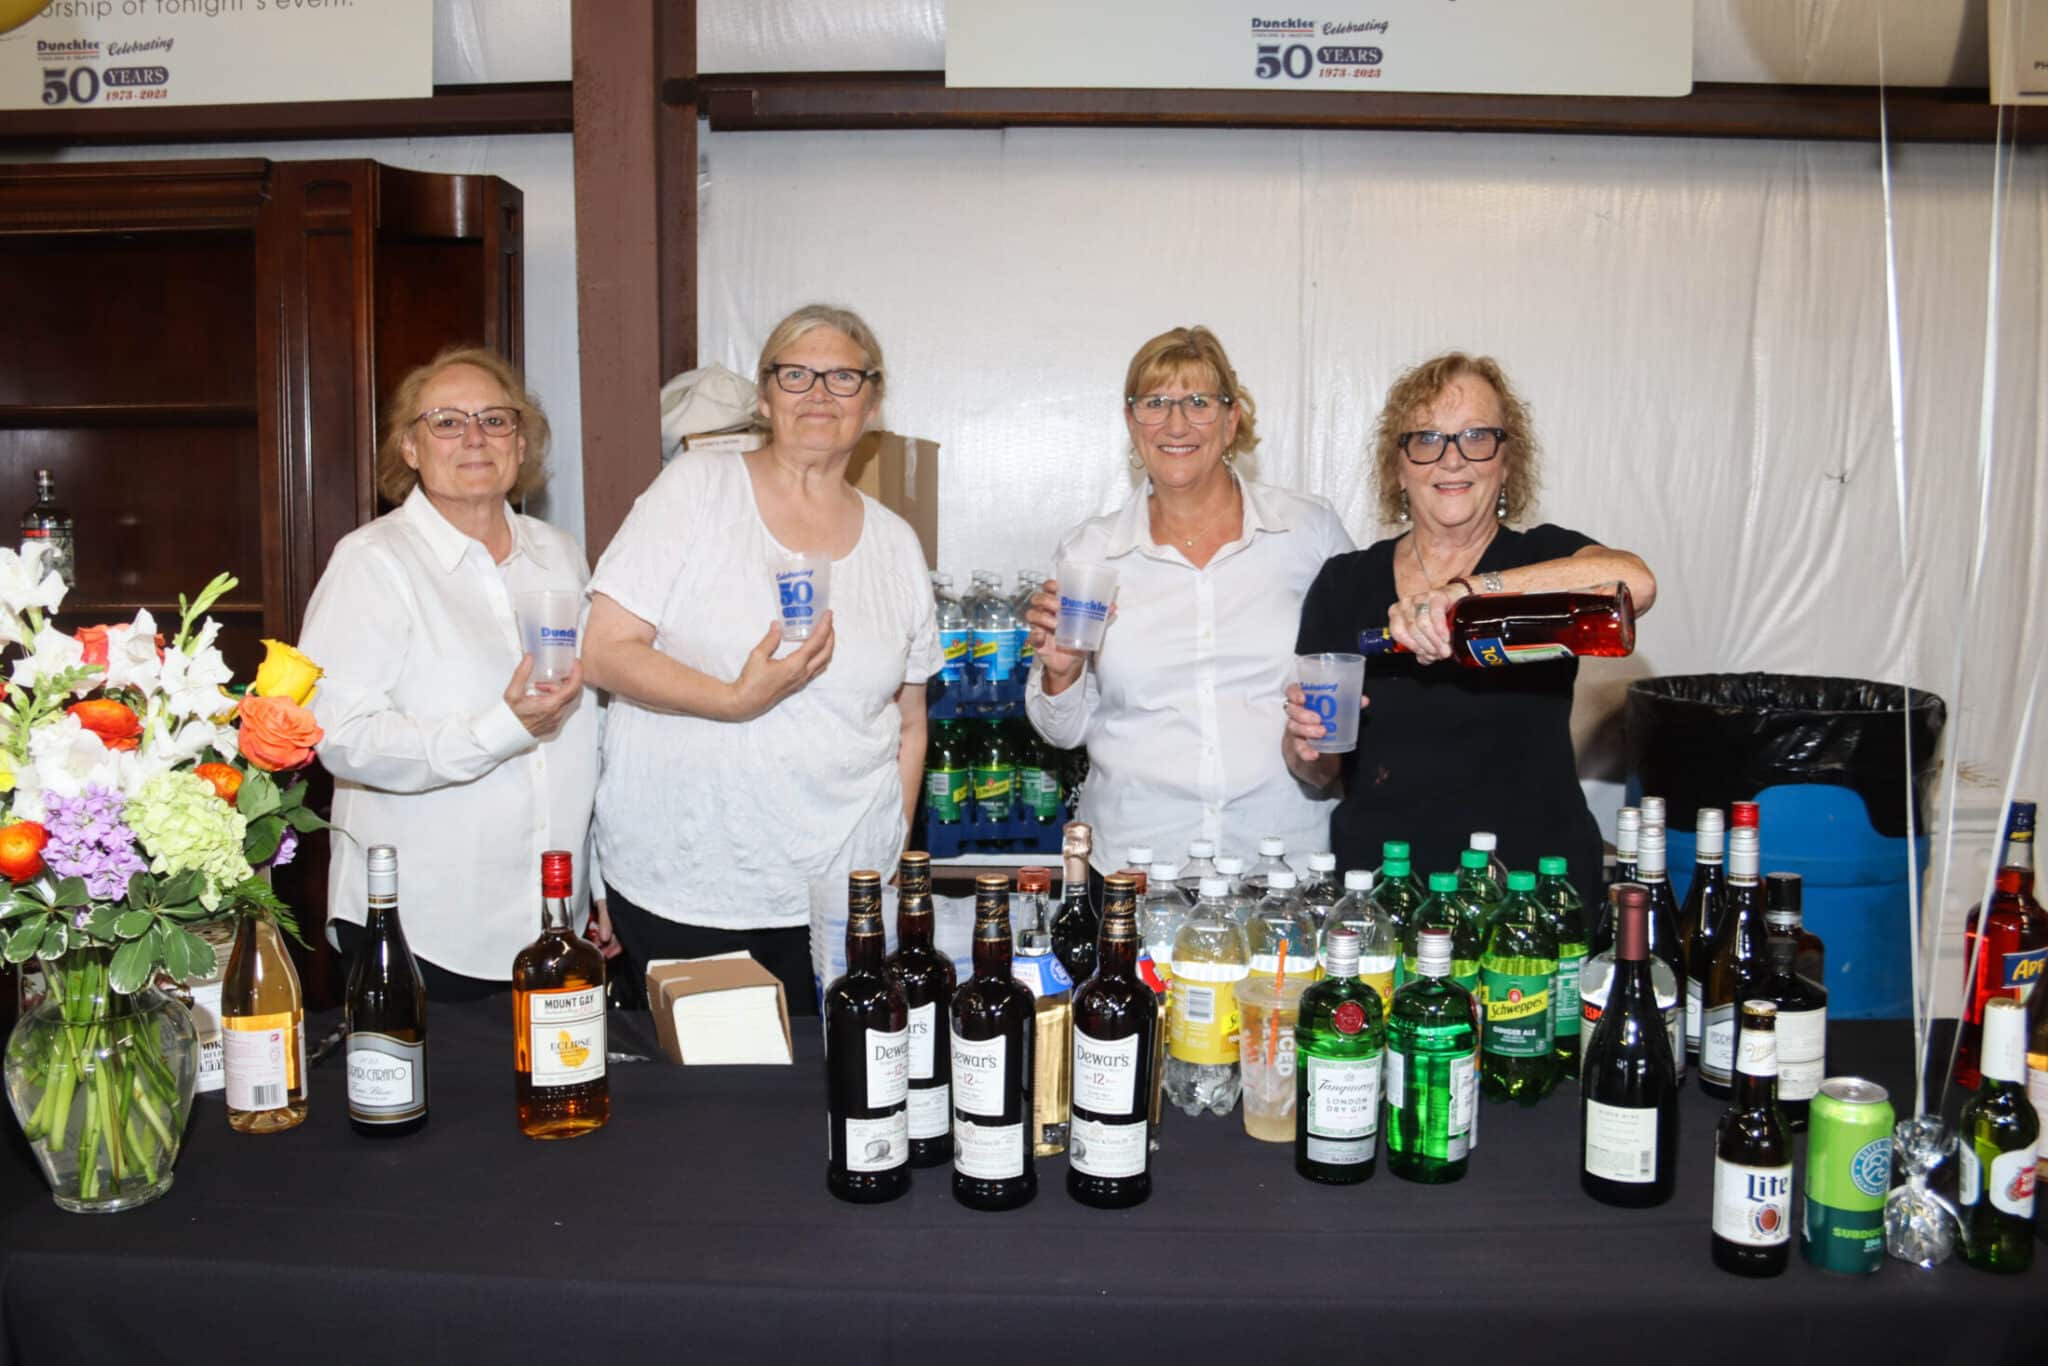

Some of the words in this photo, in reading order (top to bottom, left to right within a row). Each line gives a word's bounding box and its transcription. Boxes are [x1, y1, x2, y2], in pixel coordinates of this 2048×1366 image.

[1322, 19, 1389, 36] Celebrating
[108, 37, 174, 56] Celebrating
[1256, 43, 1313, 79] 50
[1322, 48, 1379, 62] YEARS
[42, 67, 99, 105] 50
[108, 68, 165, 84] YEARS
[779, 580, 814, 606] 50
[545, 998, 577, 1009] MOUNT
[579, 995, 594, 1006] GAY
[1491, 999, 1542, 1018] Schweppes
[1077, 1045, 1129, 1067] Dewar's
[1092, 1072, 1105, 1086] 12
[1318, 1079, 1375, 1096] Tanqueray
[1326, 1097, 1368, 1105] LONDON
[1746, 1174, 1788, 1203] Lite
